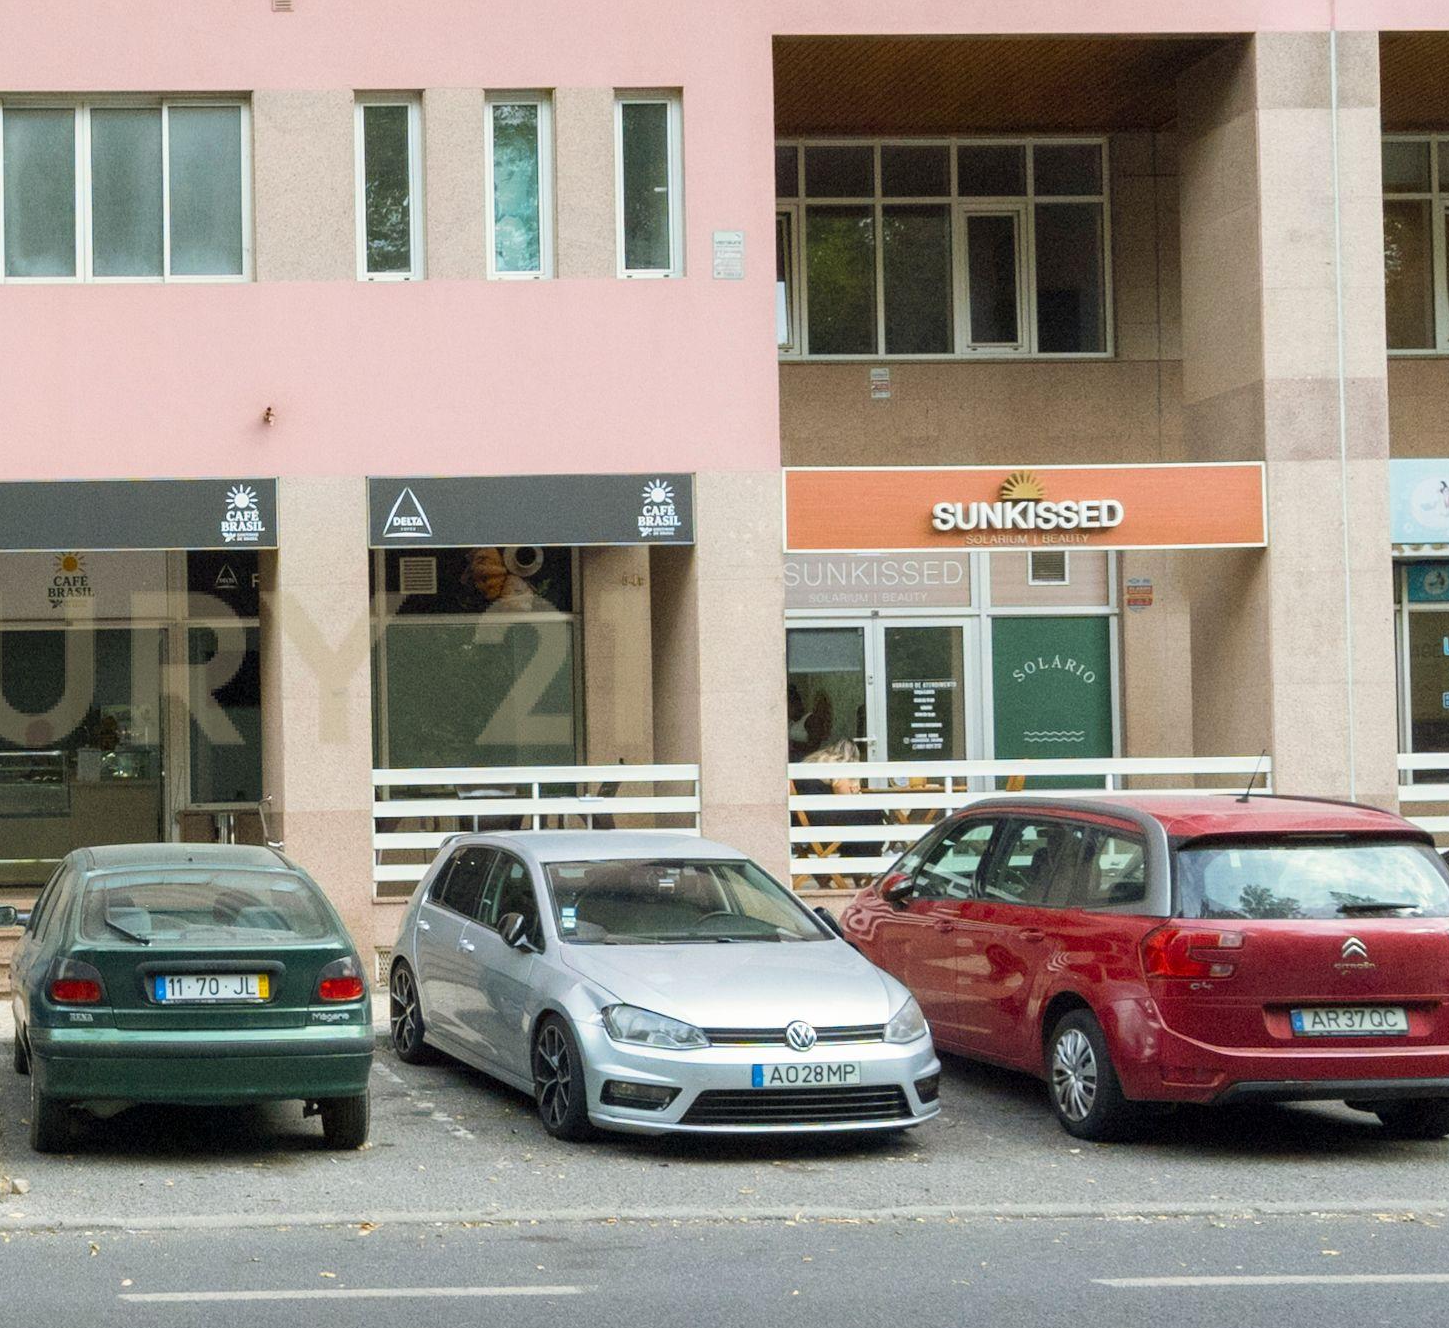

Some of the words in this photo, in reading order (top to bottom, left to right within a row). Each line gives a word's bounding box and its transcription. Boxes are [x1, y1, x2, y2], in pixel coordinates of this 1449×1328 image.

[226, 509, 259, 521] CAFÉ
[642, 504, 676, 516] CAFÉ
[932, 500, 1125, 531] SUNKISSED
[221, 521, 265, 532] BRASIL
[393, 517, 423, 526] DELTA
[638, 516, 681, 527] BRASIL
[966, 535, 1028, 546] SOLARIUM
[1042, 534, 1090, 544] BEAUTY
[784, 560, 963, 587] SUNKISSED
[48, 587, 95, 598] BRASIL
[808, 592, 868, 603] SOLARIUM
[882, 591, 928, 602] BEAUTY
[1013, 655, 1096, 684] SOLÁRIO
